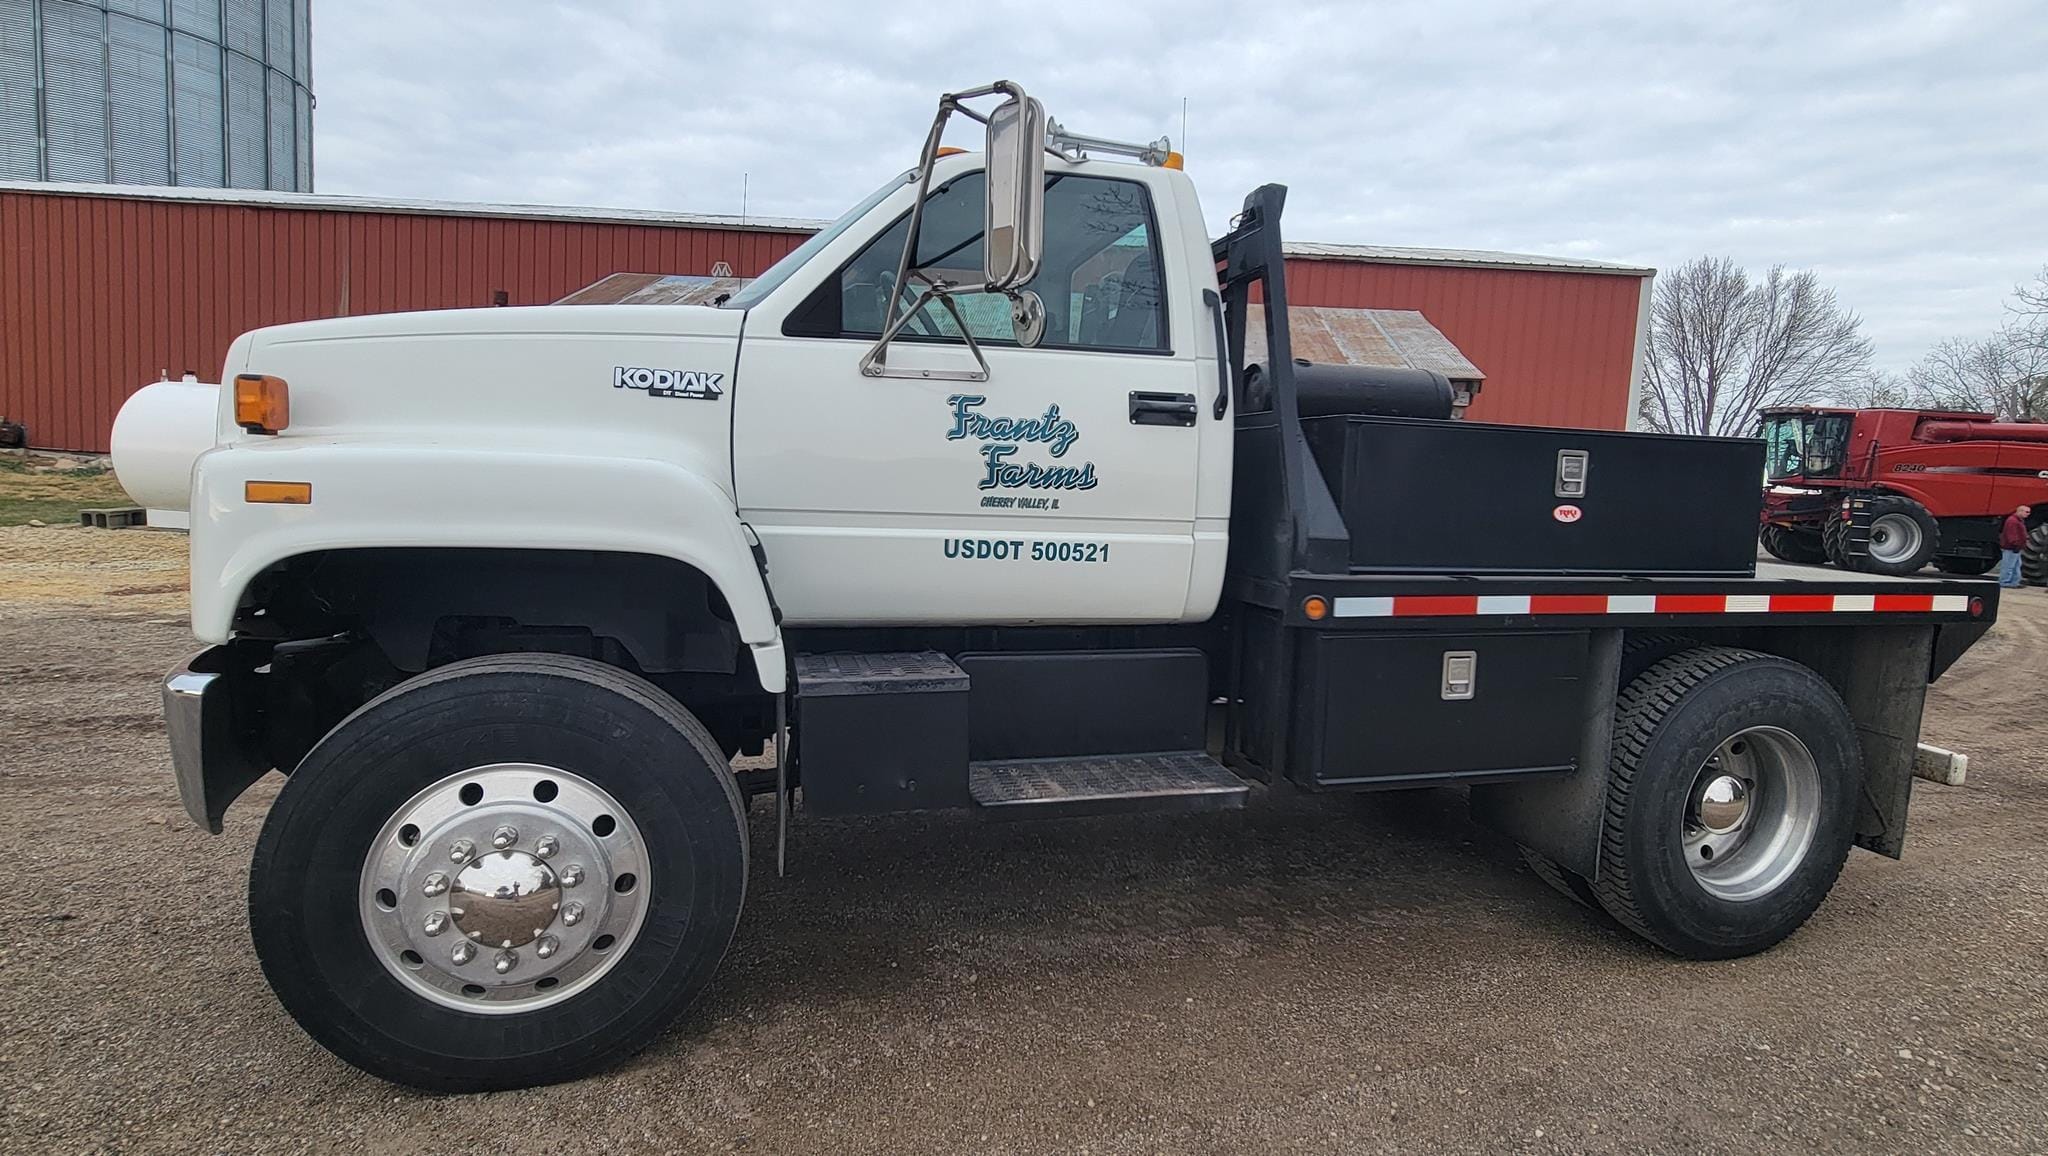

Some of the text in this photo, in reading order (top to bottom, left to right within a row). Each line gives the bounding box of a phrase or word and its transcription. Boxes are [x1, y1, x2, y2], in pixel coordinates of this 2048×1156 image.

[614, 367, 724, 394] KODIAK
[946, 394, 1079, 458] Frantz
[978, 443, 1098, 490] Farms
[1893, 463, 1926, 473] 8240
[980, 496, 1060, 511] CHERRY VALLEY, IL
[944, 539, 1109, 562] USDOT 500521
